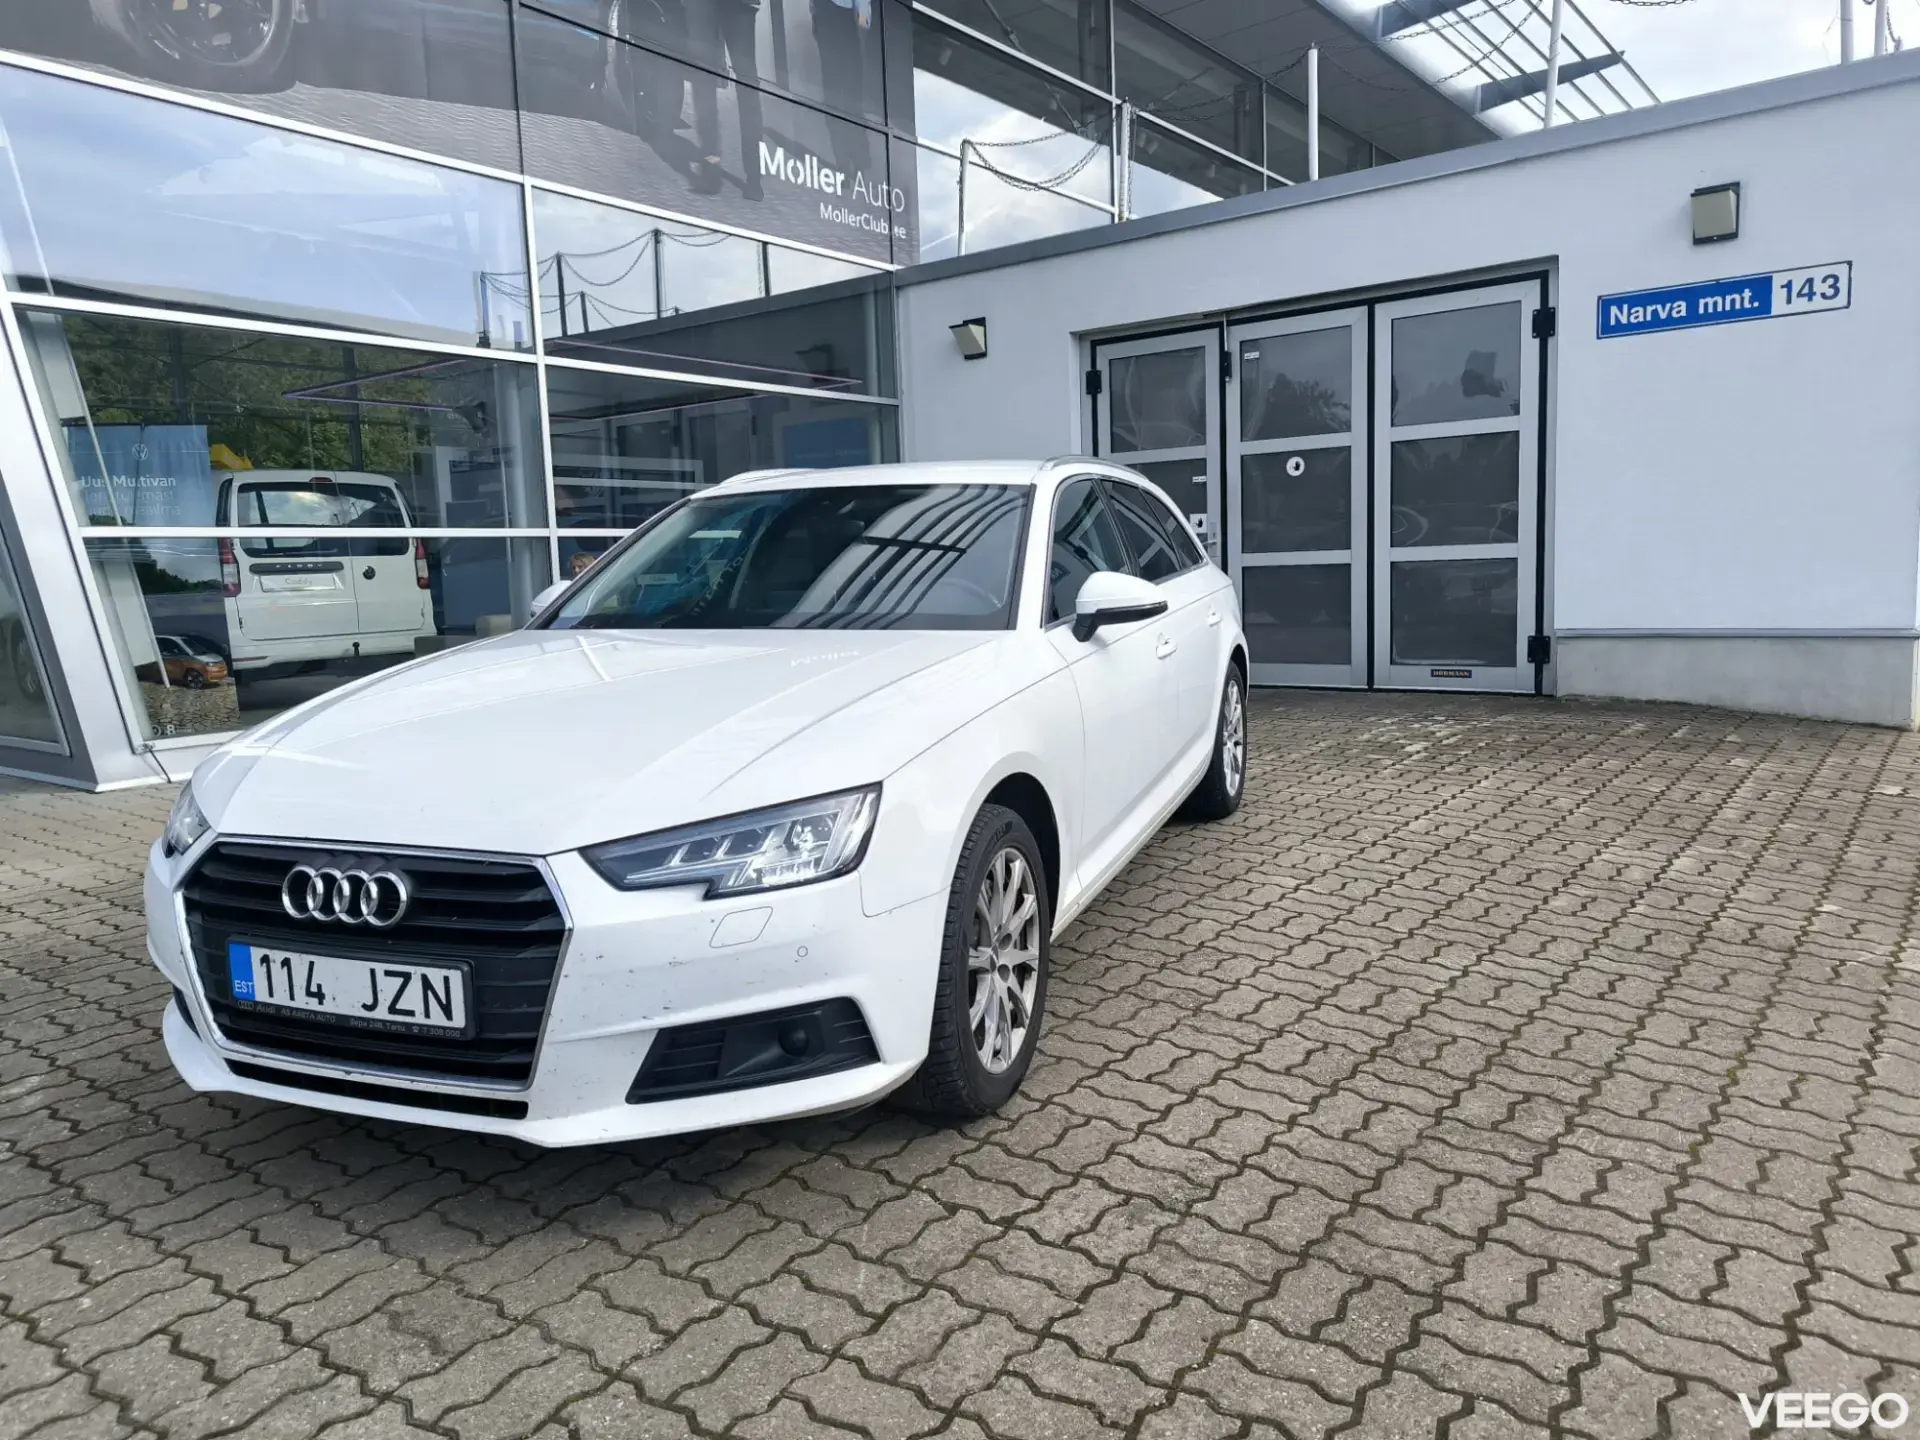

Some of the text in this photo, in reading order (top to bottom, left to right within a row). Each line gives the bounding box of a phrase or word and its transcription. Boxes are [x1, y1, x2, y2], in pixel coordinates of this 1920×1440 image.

[852, 170, 905, 212] Auto
[819, 202, 907, 239] MollerClubee
[1610, 273, 1841, 326] Narva mnt. 143
[113, 475, 176, 487] Mutivan
[235, 979, 254, 994] EST
[260, 953, 454, 1022] 114 JZN
[256, 1003, 276, 1014] Audi
